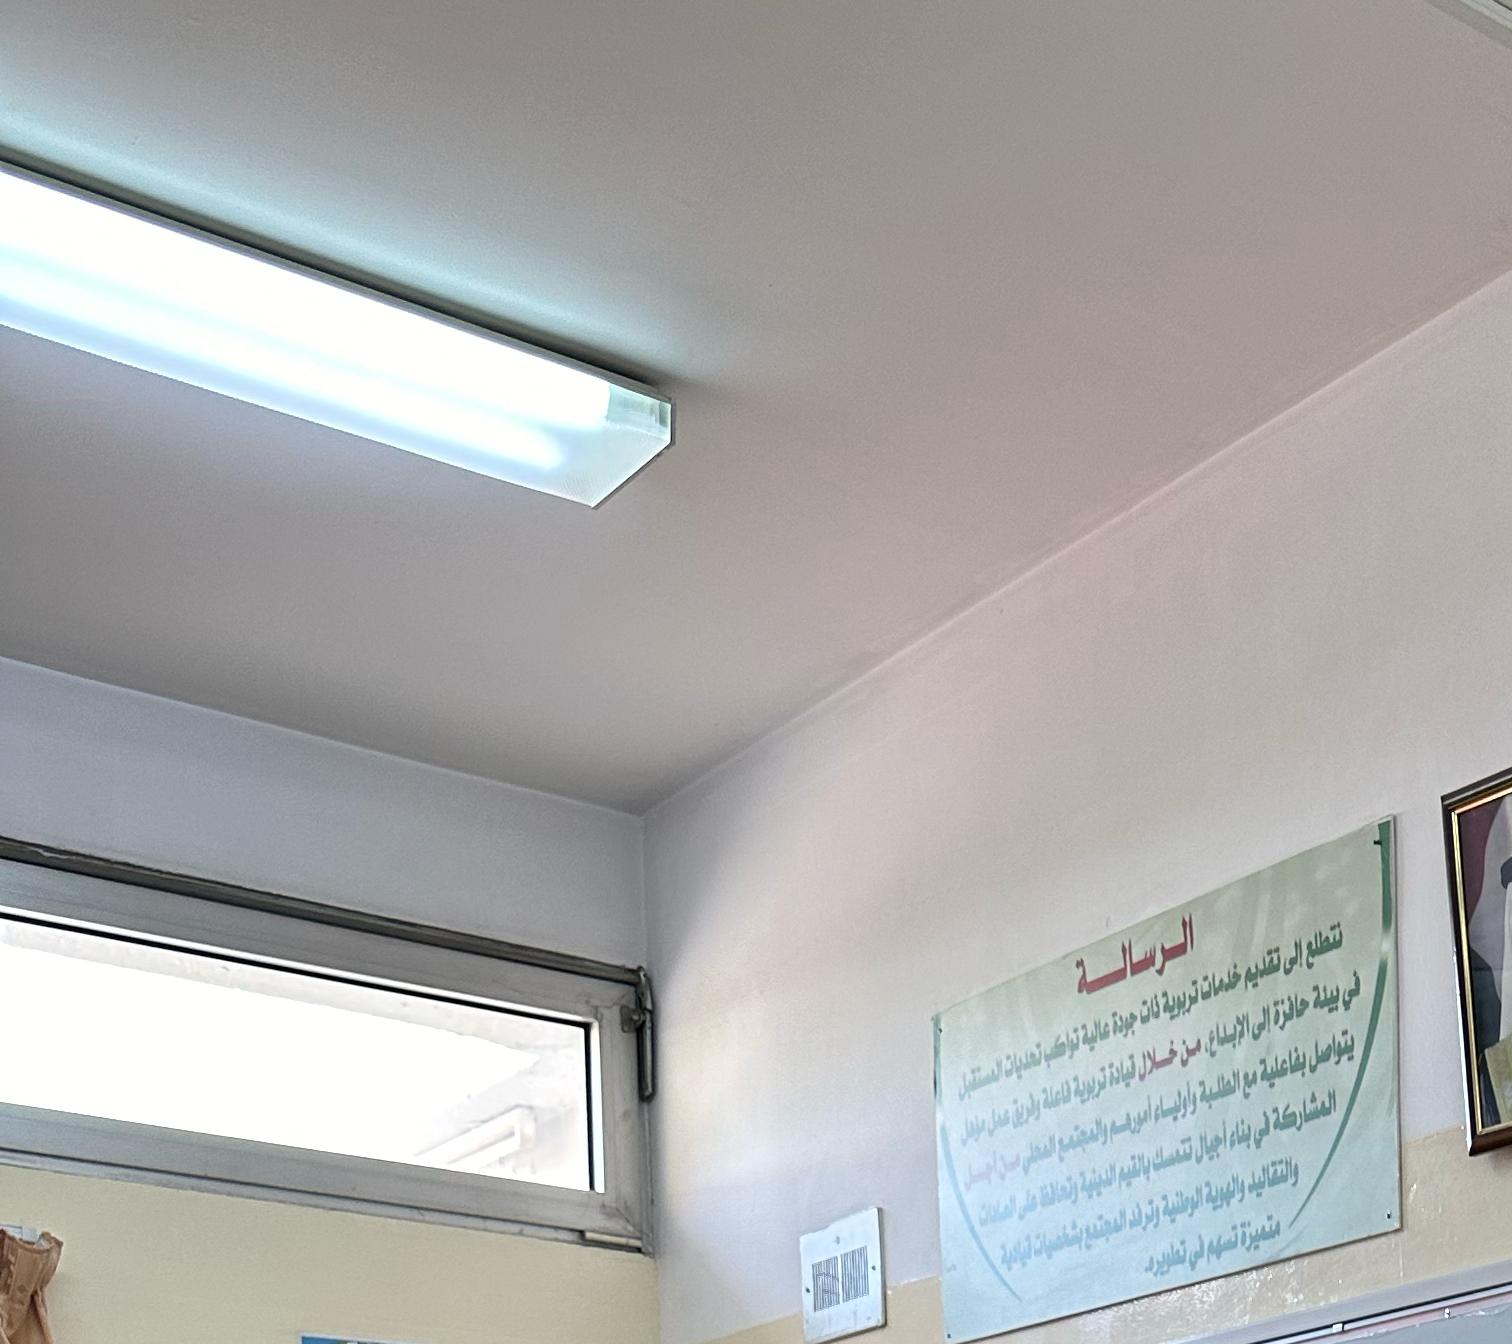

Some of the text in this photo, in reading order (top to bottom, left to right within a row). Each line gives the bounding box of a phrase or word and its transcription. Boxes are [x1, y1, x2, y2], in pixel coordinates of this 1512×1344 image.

[1283, 937, 1302, 976] إلى
[1306, 921, 1343, 970] نتطلع
[1200, 962, 1241, 1001] خدمات
[1244, 946, 1281, 992] تقديم
[1140, 993, 1161, 1025] ذات
[1162, 979, 1199, 1021] تربوية
[1312, 983, 1340, 1014] بيئة
[1342, 968, 1360, 1011] في
[1111, 1010, 1138, 1038] جودة
[1273, 993, 1309, 1031] حافزة
[1081, 1018, 1110, 1052] عالية
[1181, 1038, 1201, 1067] من
[1308, 1029, 1355, 1074] يتواصل
[1108, 1053, 1137, 1088] قيادة
[1139, 1039, 1178, 1082] خلال
[1259, 1046, 1307, 1089] بفاعلية
[1199, 1067, 1240, 1109] الطلبة
[1243, 1069, 1258, 1101] مع
[1254, 1110, 1270, 1149] في
[1272, 1088, 1336, 1132] المشاركة
[1195, 1118, 1227, 1165] أجيال
[1229, 1116, 1251, 1150] بناء
[1205, 1173, 1245, 1211] والهوية
[1247, 1156, 1299, 1198] والتقاليد
[1162, 1183, 1203, 1224] الوطنية
[1188, 1233, 1204, 1272] في
[1207, 1224, 1238, 1263] تسهم
[1240, 1214, 1281, 1252] متميزة
